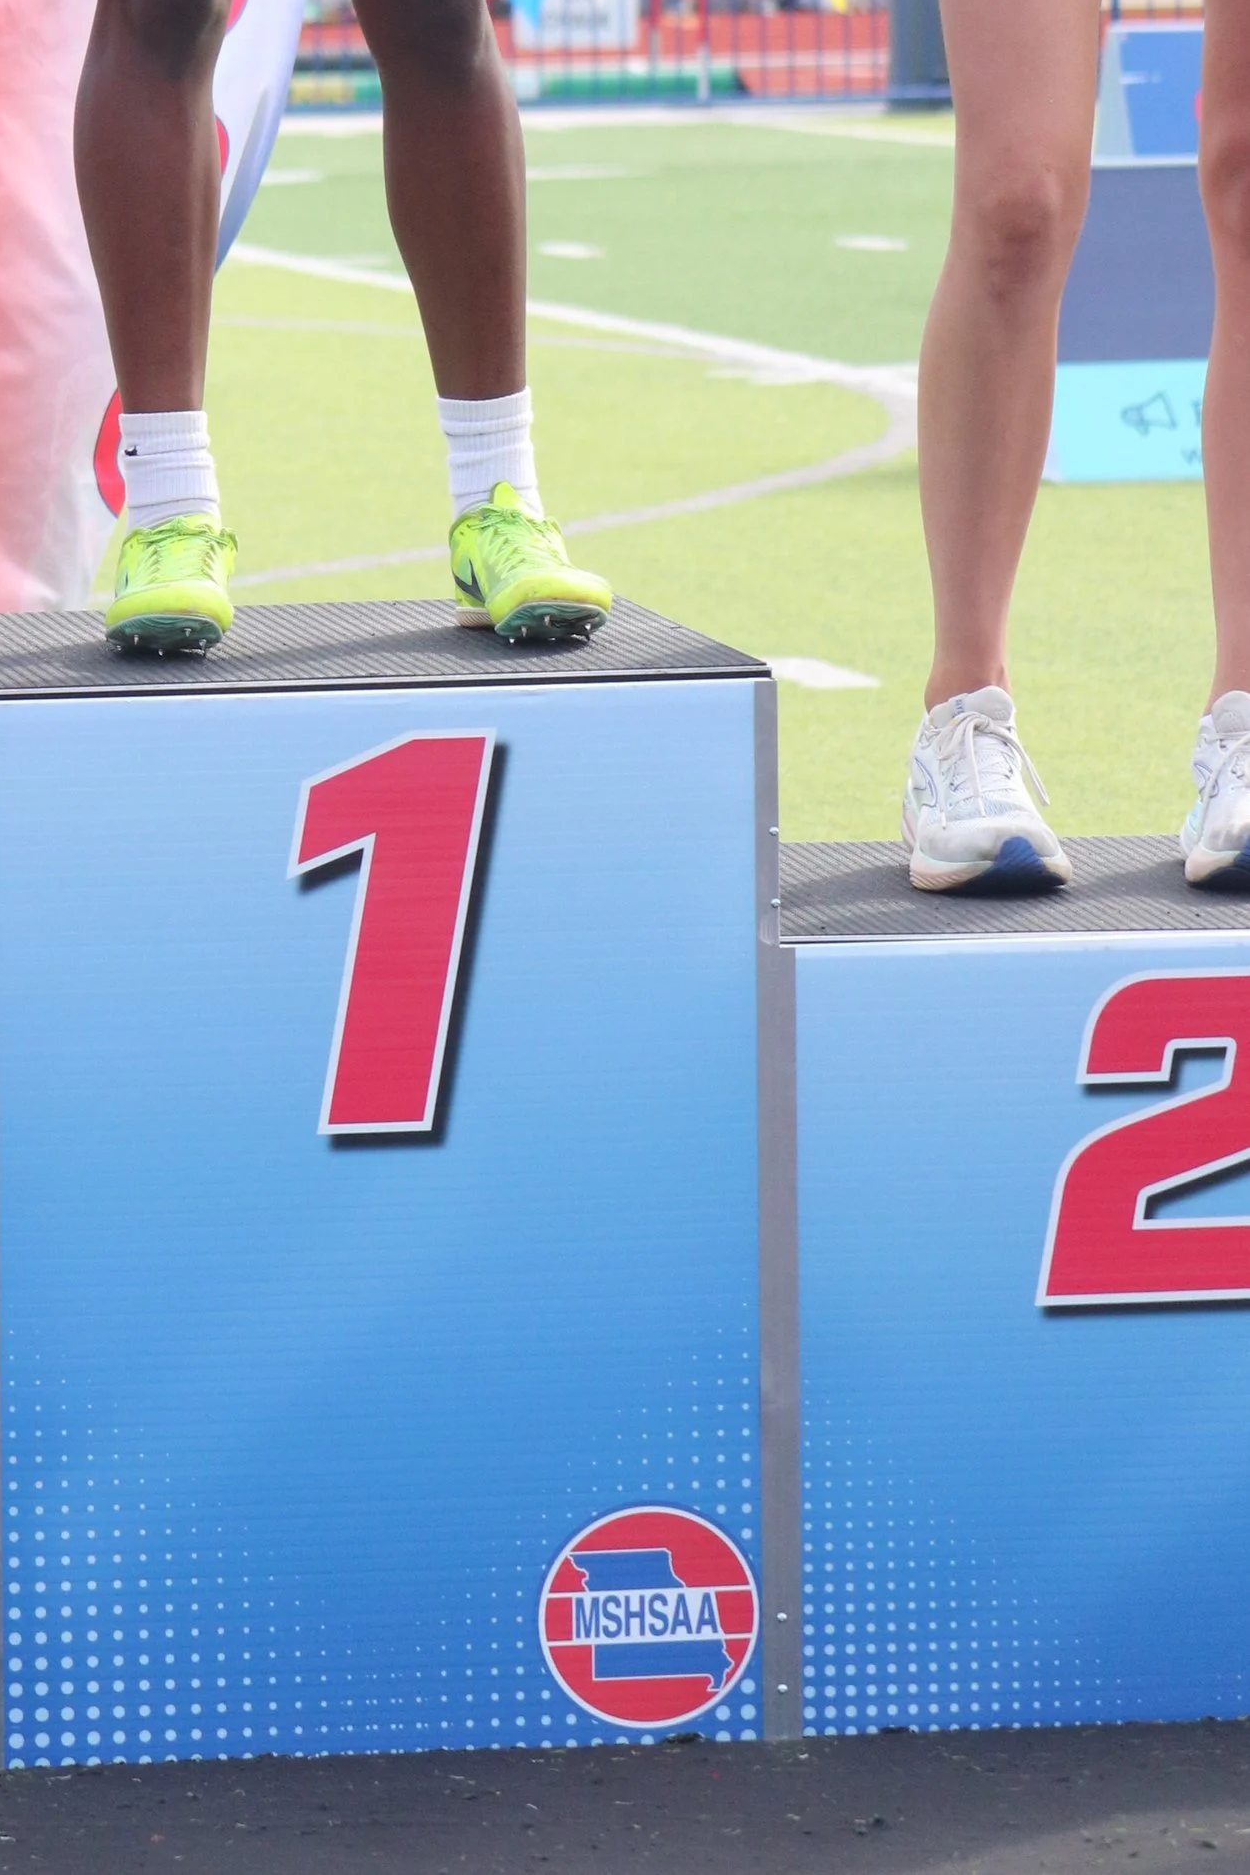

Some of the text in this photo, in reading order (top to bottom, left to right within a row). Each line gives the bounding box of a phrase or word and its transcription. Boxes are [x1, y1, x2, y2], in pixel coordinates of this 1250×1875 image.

[286, 728, 497, 1135] 1
[1034, 965, 1250, 1306] 2
[574, 1591, 719, 1640] MSHSAA
